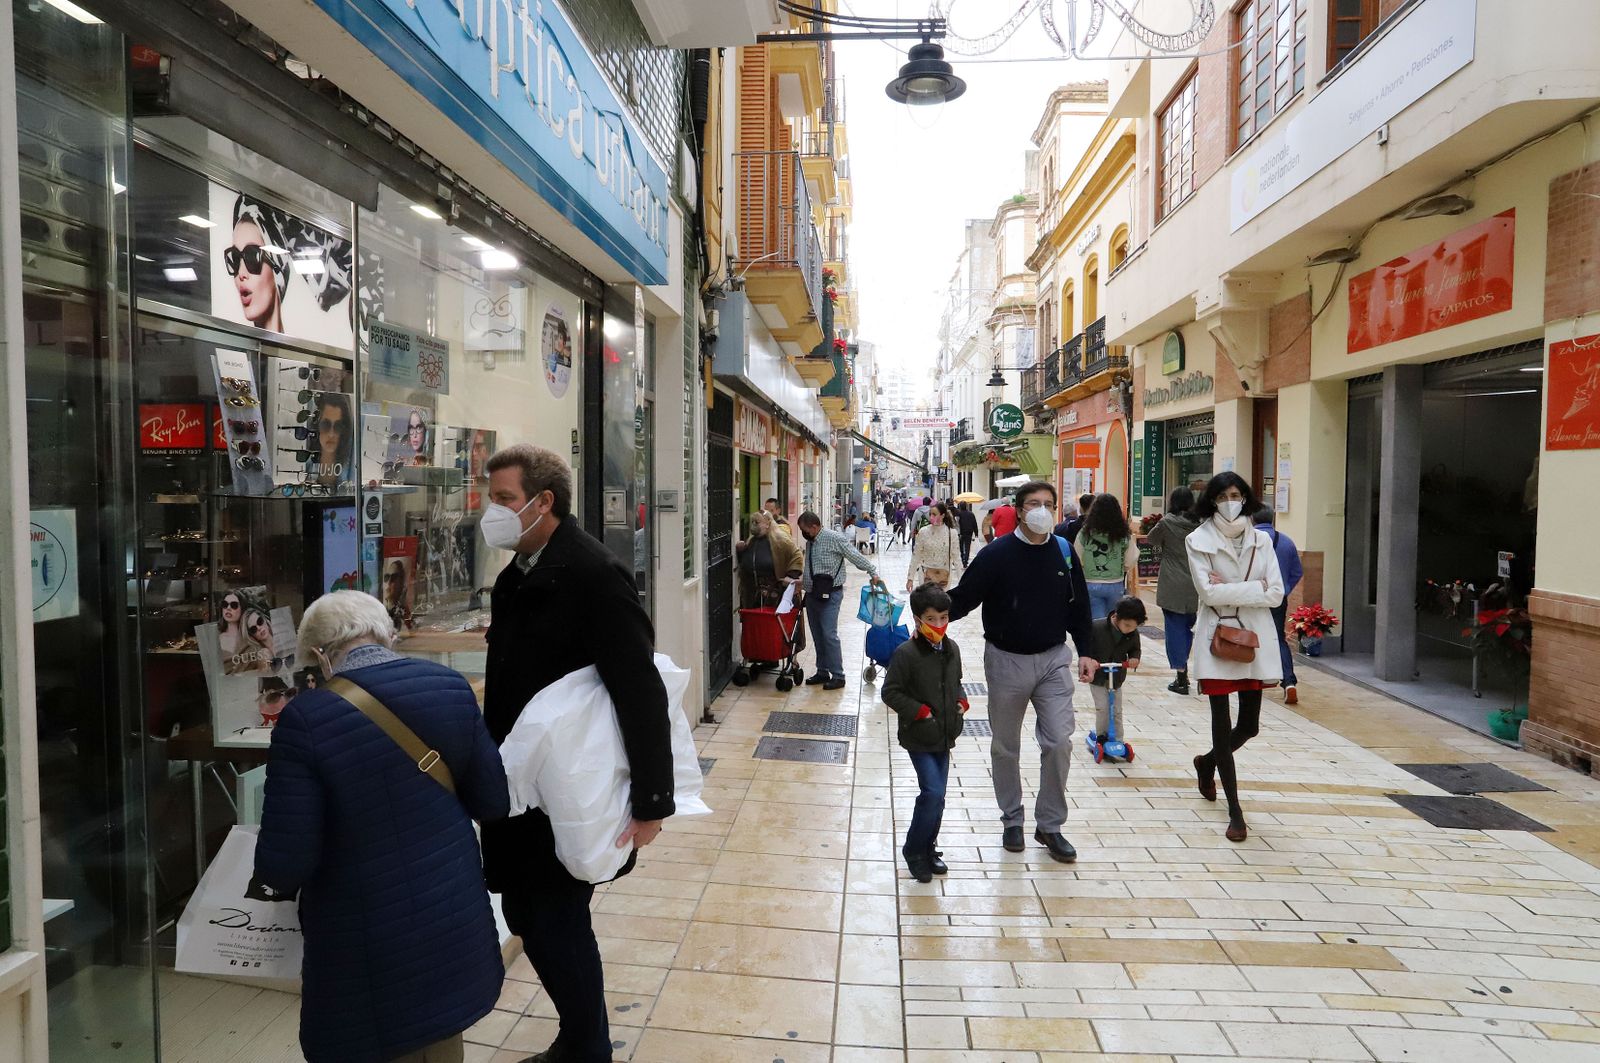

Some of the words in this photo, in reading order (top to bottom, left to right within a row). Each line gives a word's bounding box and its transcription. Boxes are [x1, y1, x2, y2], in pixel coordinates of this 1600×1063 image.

[1348, 99, 1375, 126] Seguros
[1379, 75, 1404, 100] Ahorro
[1410, 34, 1454, 78] Pensiones
[1258, 153, 1301, 194] nederlanden
[1259, 143, 1290, 177] nationale
[1440, 292, 1495, 317] ZAPATOS
[371, 333, 383, 346] POR
[385, 336, 391, 348] TU
[1150, 425, 1158, 491] Herbolario
